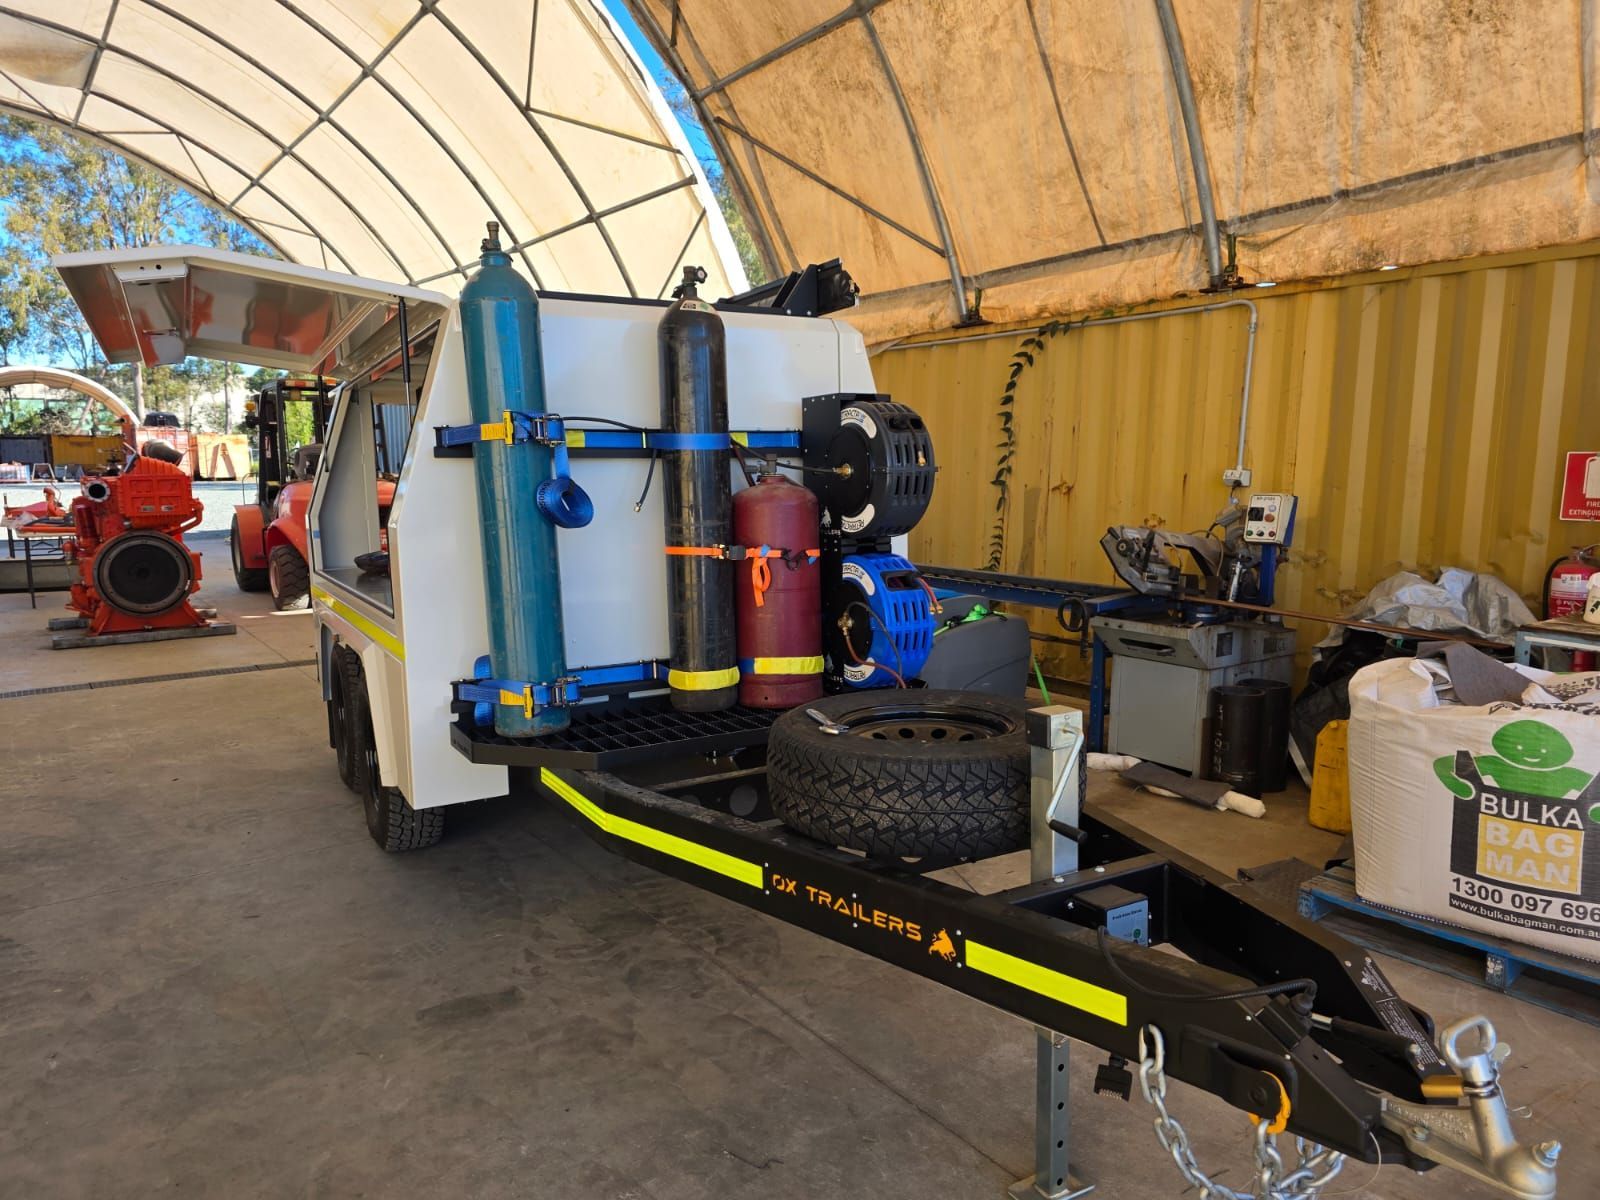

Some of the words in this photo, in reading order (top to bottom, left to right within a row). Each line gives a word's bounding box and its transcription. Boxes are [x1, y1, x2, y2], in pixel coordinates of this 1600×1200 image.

[1480, 792, 1584, 829] BULKA
[1485, 821, 1576, 858] BAG
[1485, 850, 1571, 885] MAN
[772, 874, 797, 895] OX
[806, 885, 922, 942] TRAILERS
[1450, 897, 1600, 938] www.bulkabagman.com.au
[1452, 877, 1503, 904] 1300
[1511, 893, 1553, 914] 097
[1560, 902, 1600, 923] 696
